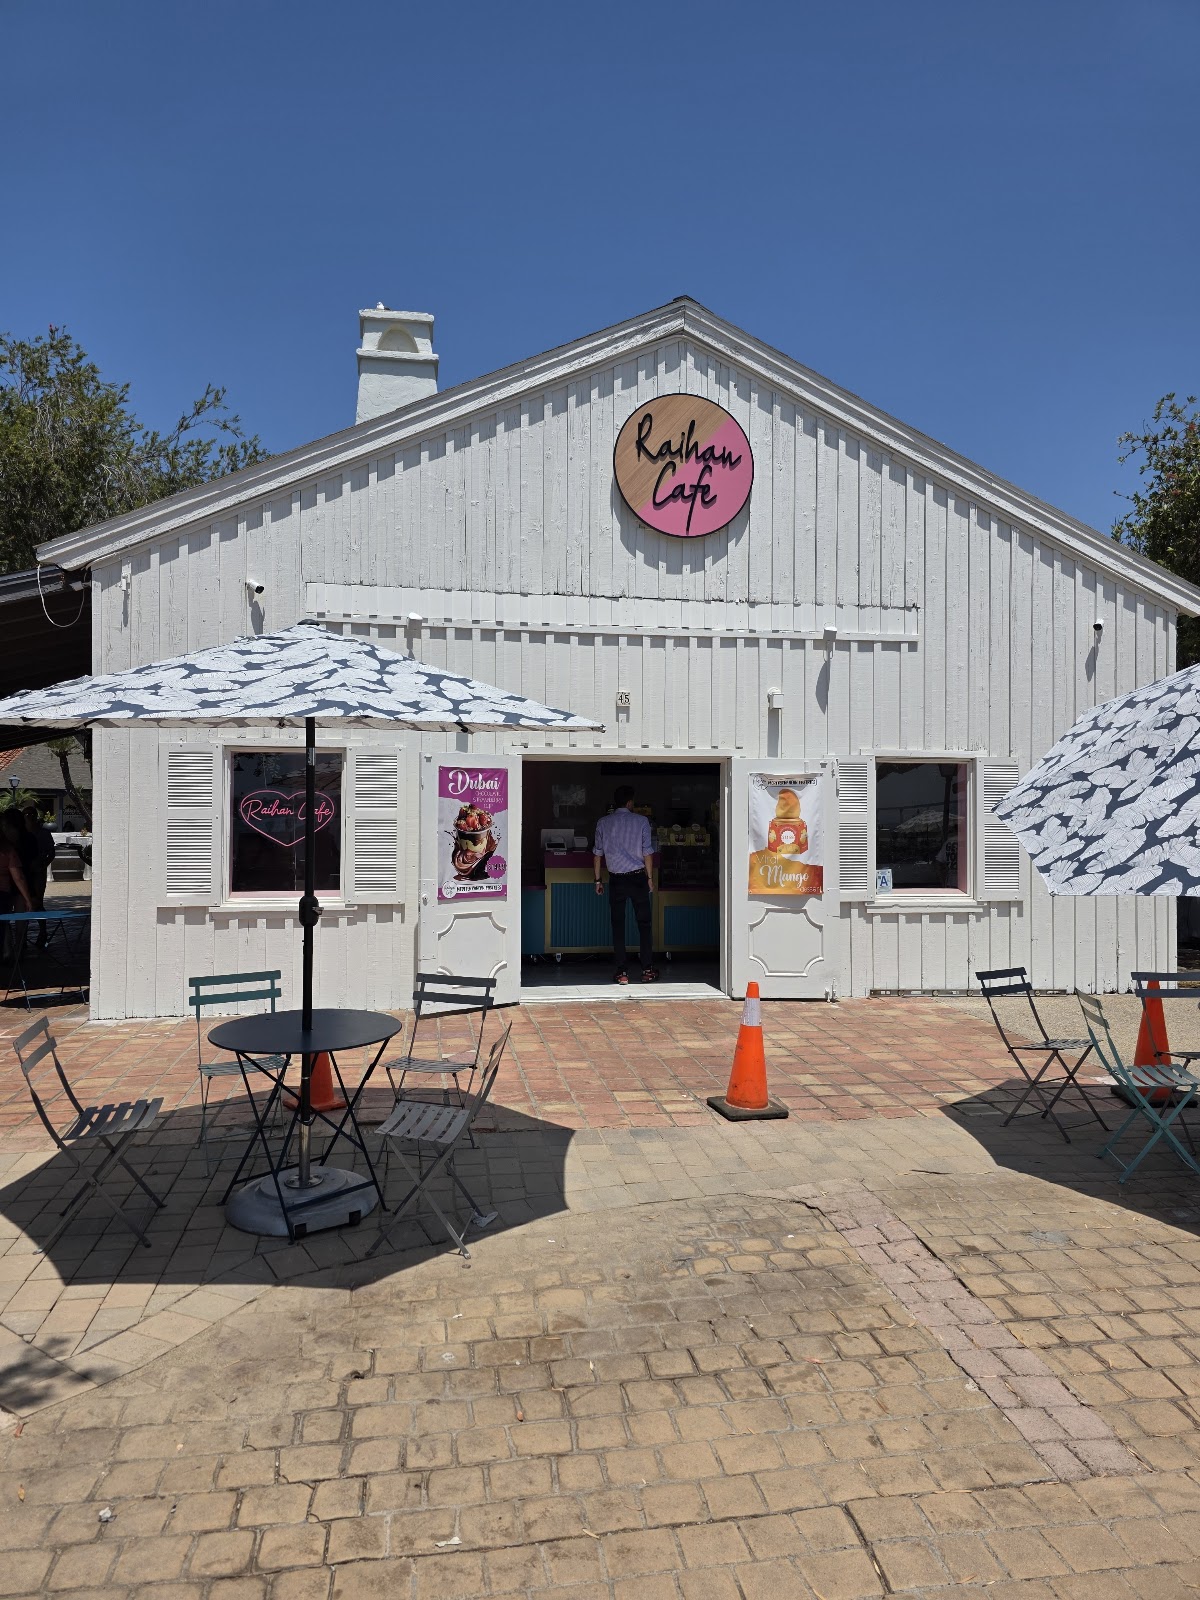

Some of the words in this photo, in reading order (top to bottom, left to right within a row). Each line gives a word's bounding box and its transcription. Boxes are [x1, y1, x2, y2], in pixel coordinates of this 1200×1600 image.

[636, 412, 742, 470] Raihan
[653, 460, 718, 534] Cafe
[617, 694, 630, 704] 45
[448, 769, 501, 795] Dubai
[242, 799, 294, 821] Raihan
[755, 854, 779, 865] Viral
[759, 864, 810, 889] Mango
[880, 875, 889, 886] A
